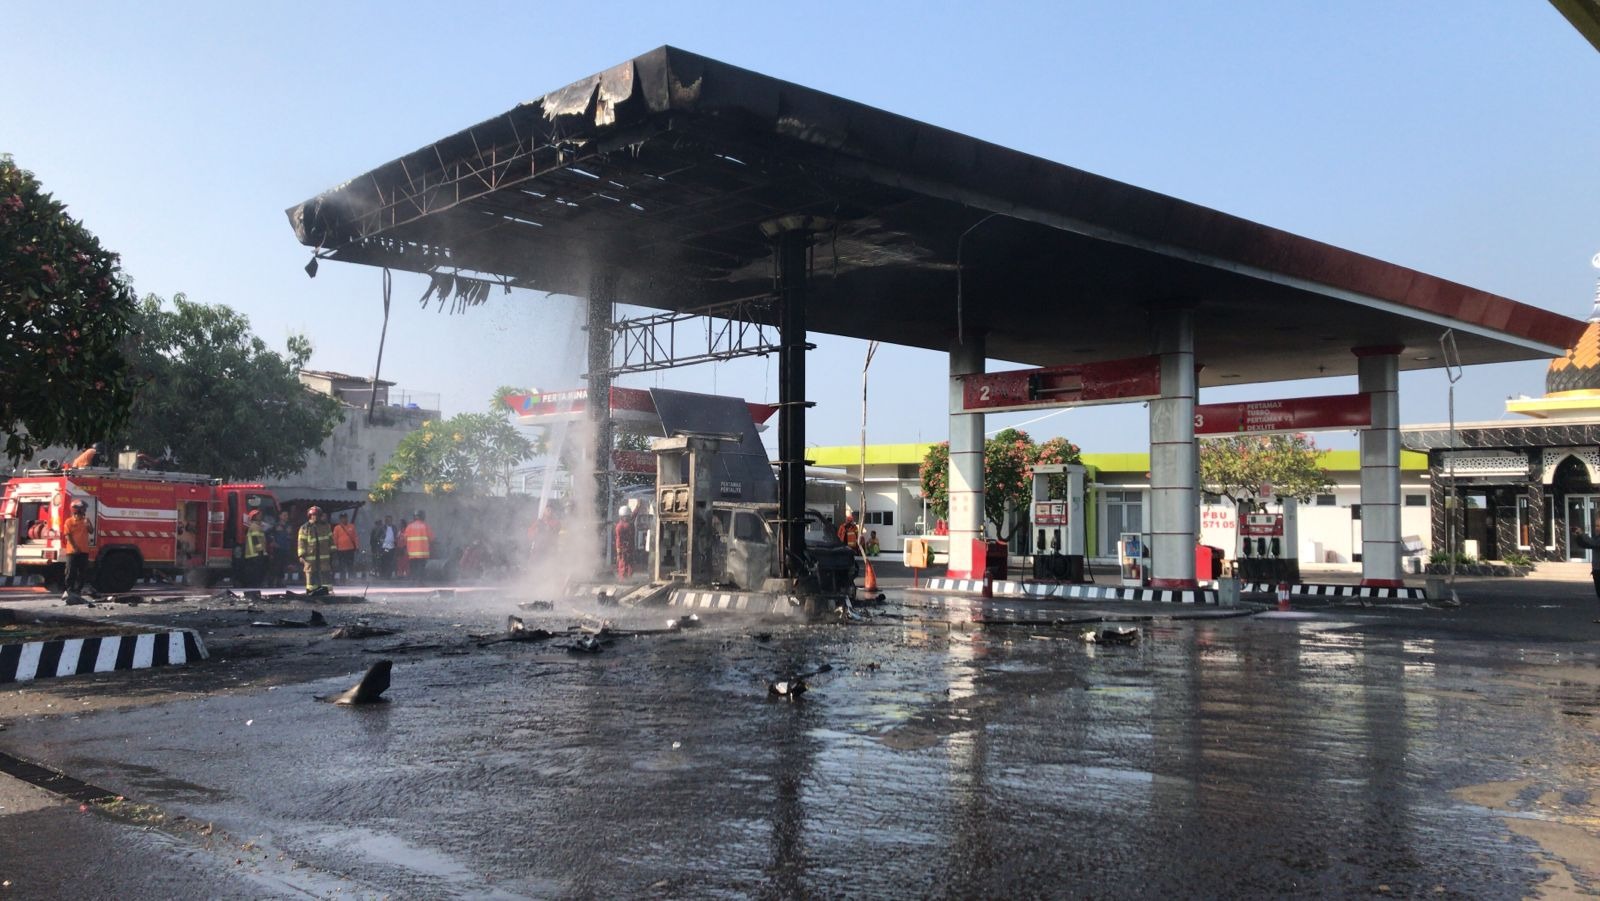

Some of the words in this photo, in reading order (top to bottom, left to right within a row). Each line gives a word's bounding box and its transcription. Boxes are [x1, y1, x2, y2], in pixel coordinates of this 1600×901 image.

[542, 390, 589, 403] PERTAMINA
[979, 385, 990, 401] 2
[1247, 401, 1282, 410] PERTAMAX
[1194, 414, 1204, 428] 3
[1247, 415, 1282, 423] PERTAMAX
